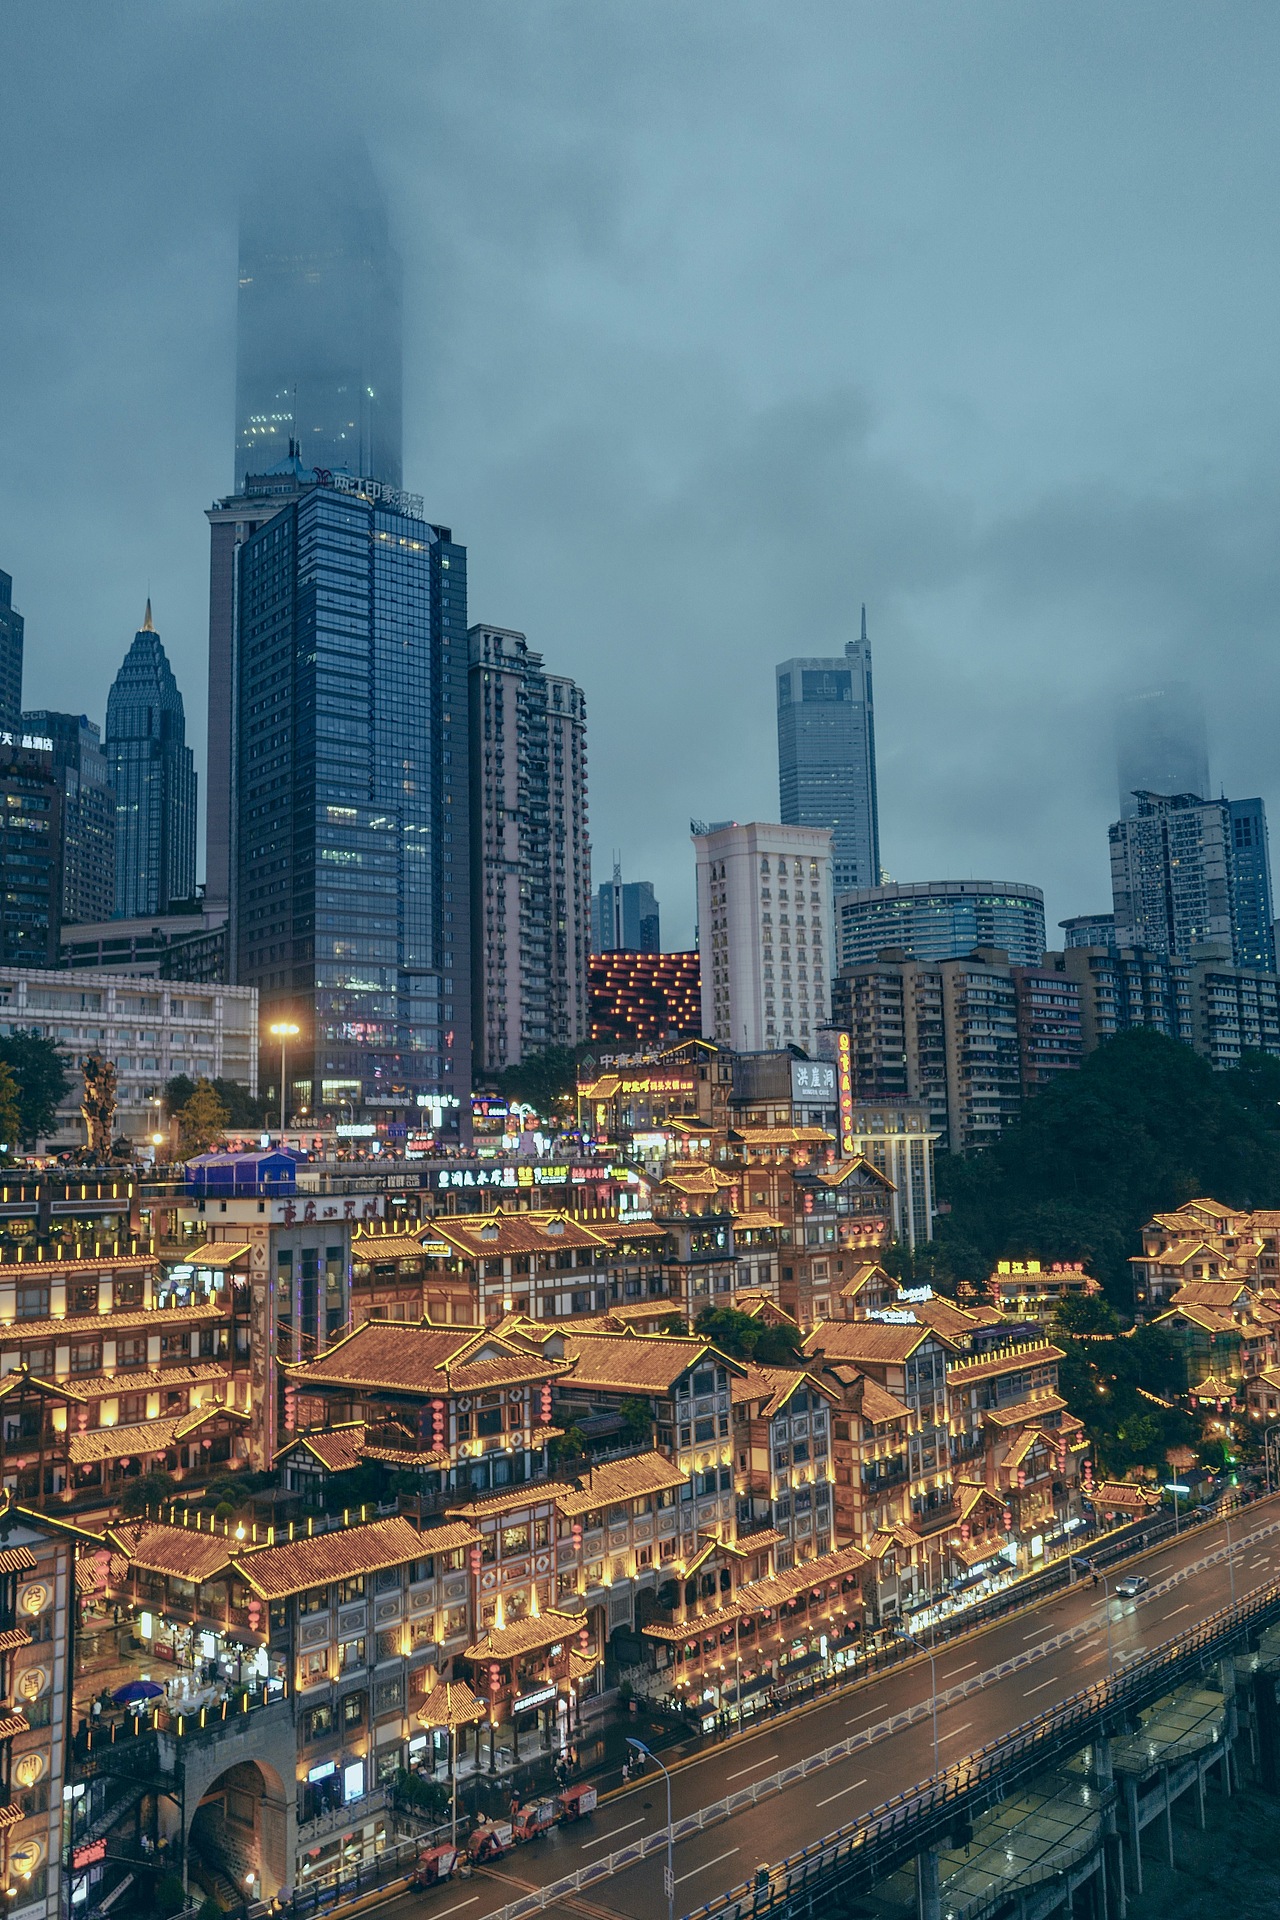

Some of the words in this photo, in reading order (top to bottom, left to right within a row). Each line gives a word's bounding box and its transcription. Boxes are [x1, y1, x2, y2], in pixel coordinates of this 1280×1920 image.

[334, 472, 424, 513] 两江印象酒店
[22, 711, 47, 720] CCB
[797, 1067, 834, 1088] 洪崖洞
